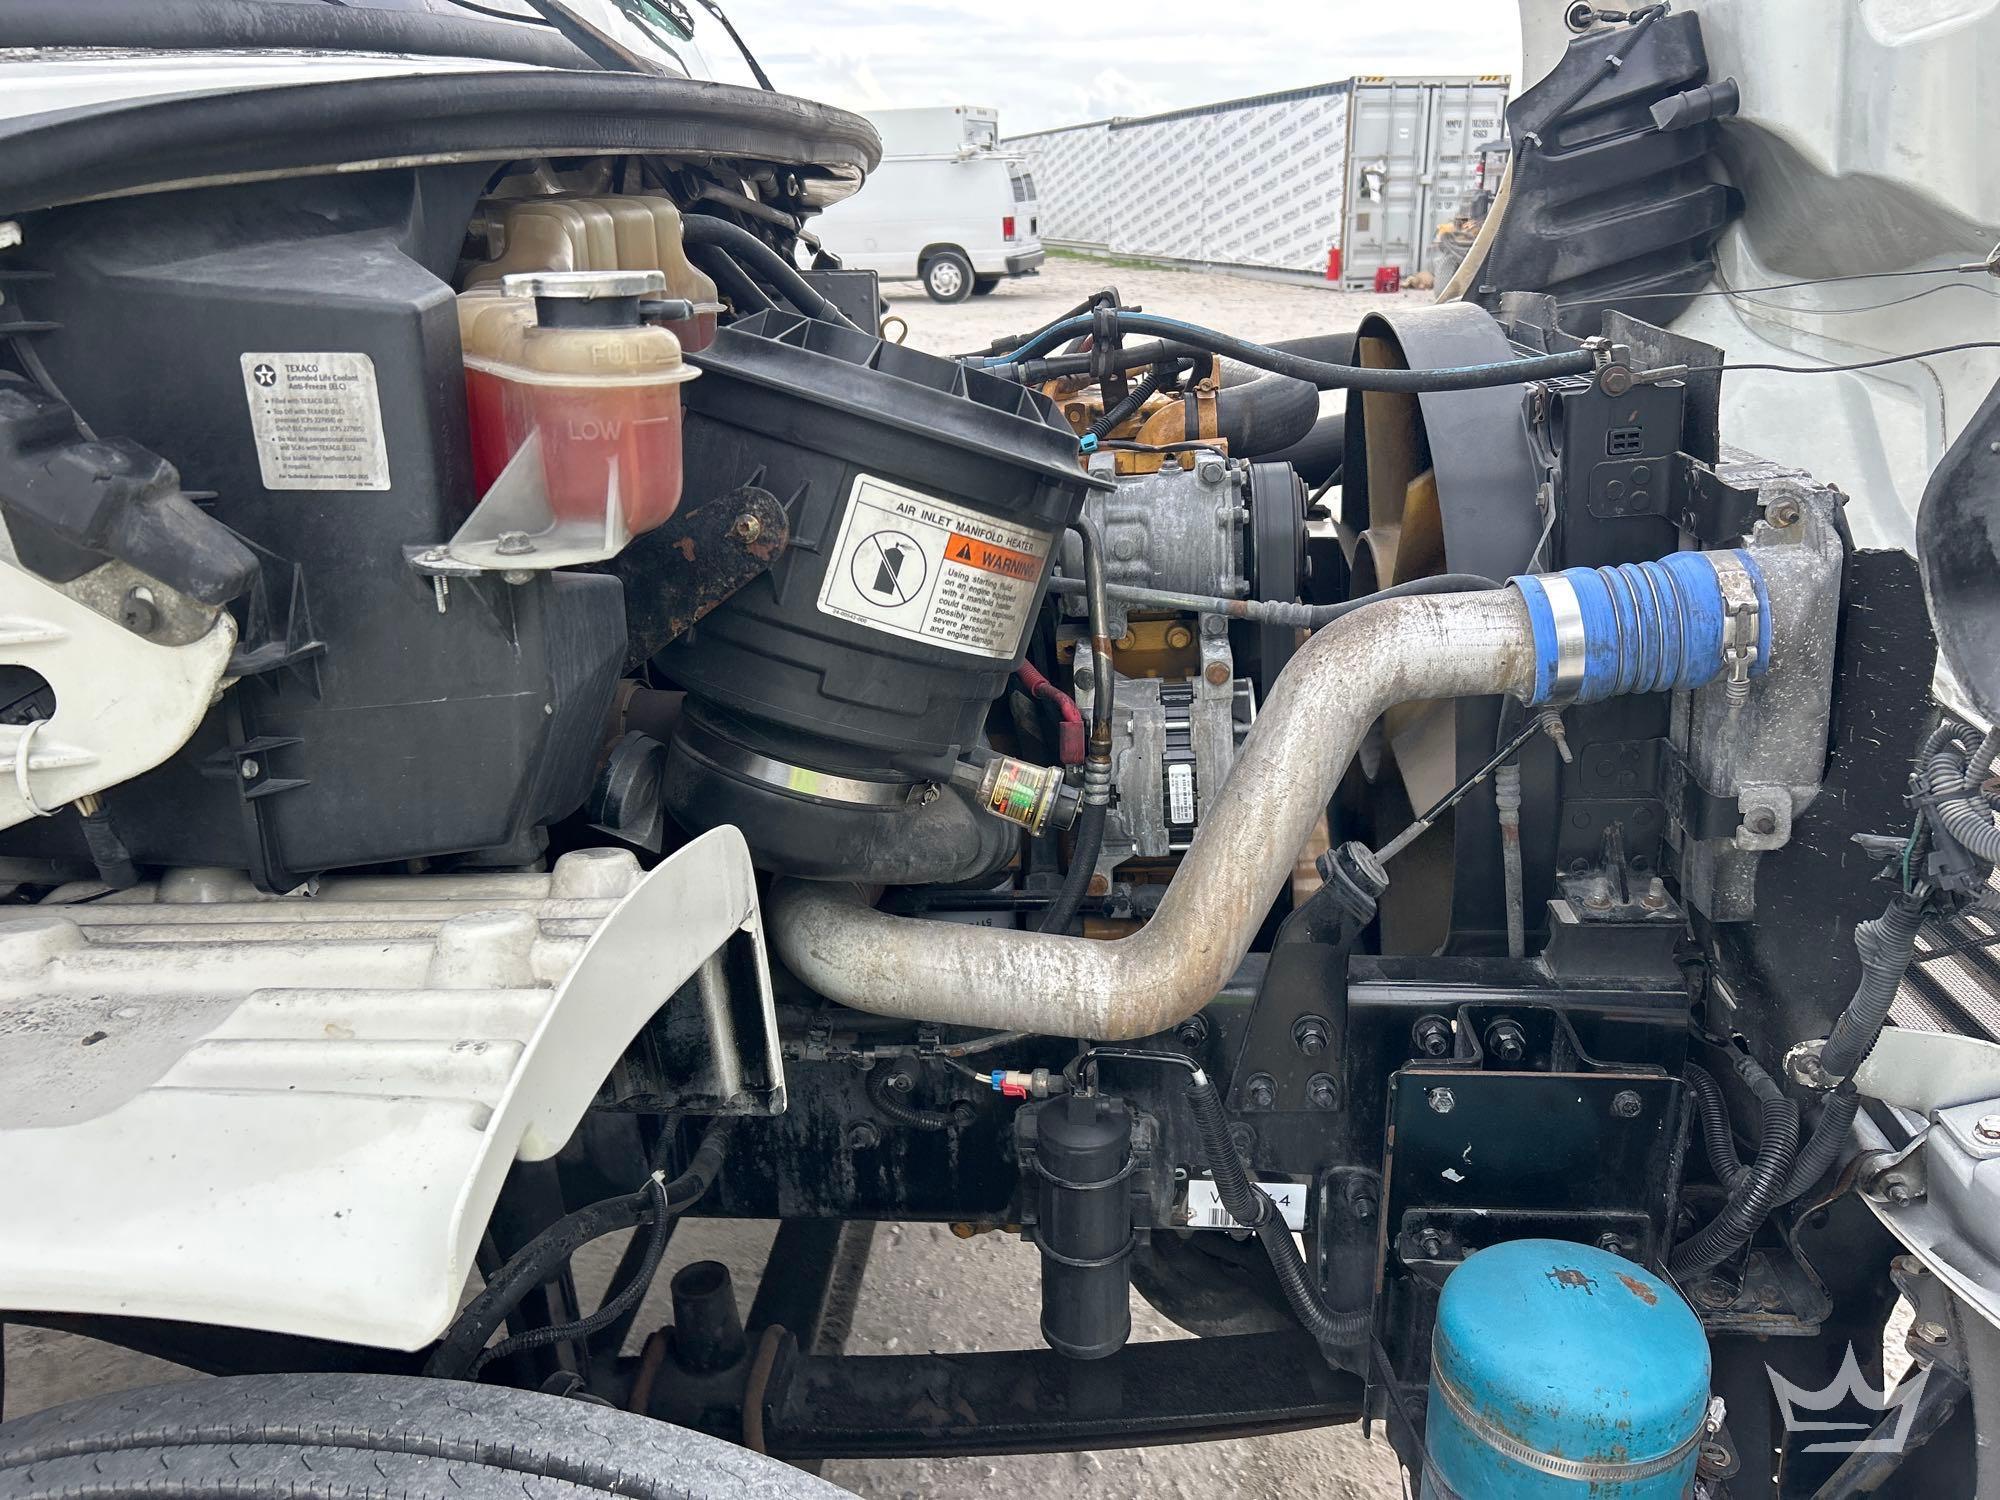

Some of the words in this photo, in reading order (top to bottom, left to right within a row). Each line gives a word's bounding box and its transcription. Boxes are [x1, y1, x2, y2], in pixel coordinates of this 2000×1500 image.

[592, 342, 654, 366] FULL
[285, 364, 319, 372] TEXACO
[328, 382, 346, 390] (ELC)
[568, 420, 622, 440] LOW
[896, 502, 917, 516] AIR
[920, 510, 952, 528] INLET
[956, 522, 1004, 543] MANIFOLD
[1006, 537, 1034, 552] HEATER
[983, 551, 1036, 578] WARNING
[948, 568, 970, 582] Using
[972, 576, 998, 590] starting
[1000, 582, 1014, 592] fluid
[942, 588, 958, 598] with
[967, 595, 994, 606] manifold
[996, 602, 1012, 610] heater
[969, 585, 990, 596] engine
[992, 591, 1016, 602] equipped
[938, 598, 960, 608] could
[962, 604, 980, 613] cause
[933, 616, 958, 628] severe
[960, 623, 988, 634] personal
[990, 630, 1005, 640] injury
[936, 607, 967, 620] possibly
[970, 616, 996, 628] resulting
[930, 626, 944, 634] and
[946, 630, 970, 640] engine
